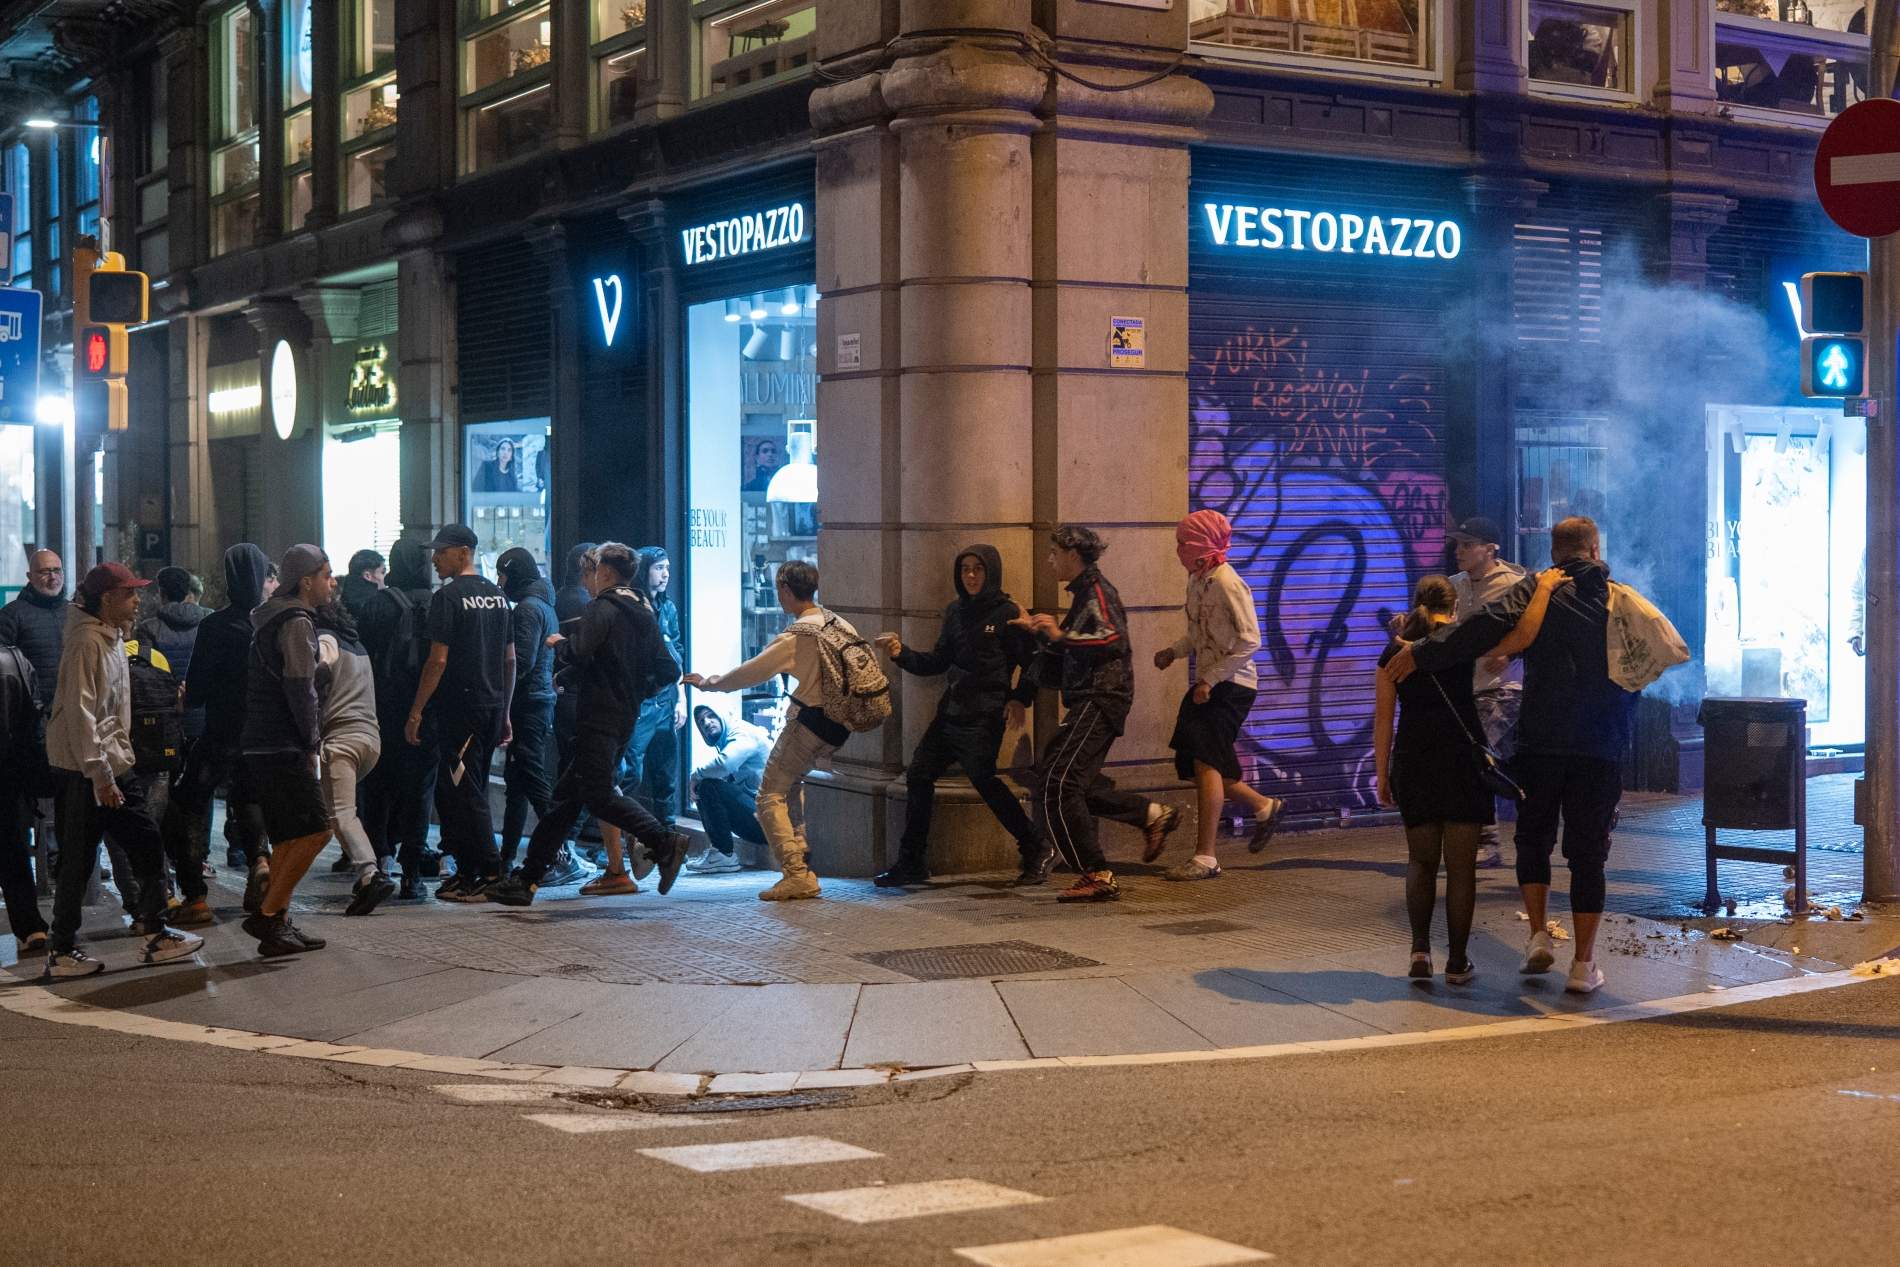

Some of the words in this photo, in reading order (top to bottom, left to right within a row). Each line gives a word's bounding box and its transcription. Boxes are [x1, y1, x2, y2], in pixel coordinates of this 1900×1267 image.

[682, 203, 804, 265] VESTOPAZZO
[1204, 203, 1461, 259] VESTOPAZZO
[690, 508, 702, 527] BE
[703, 508, 728, 528] YOUR
[145, 533, 160, 551] P
[690, 529, 727, 548] BEAUTY
